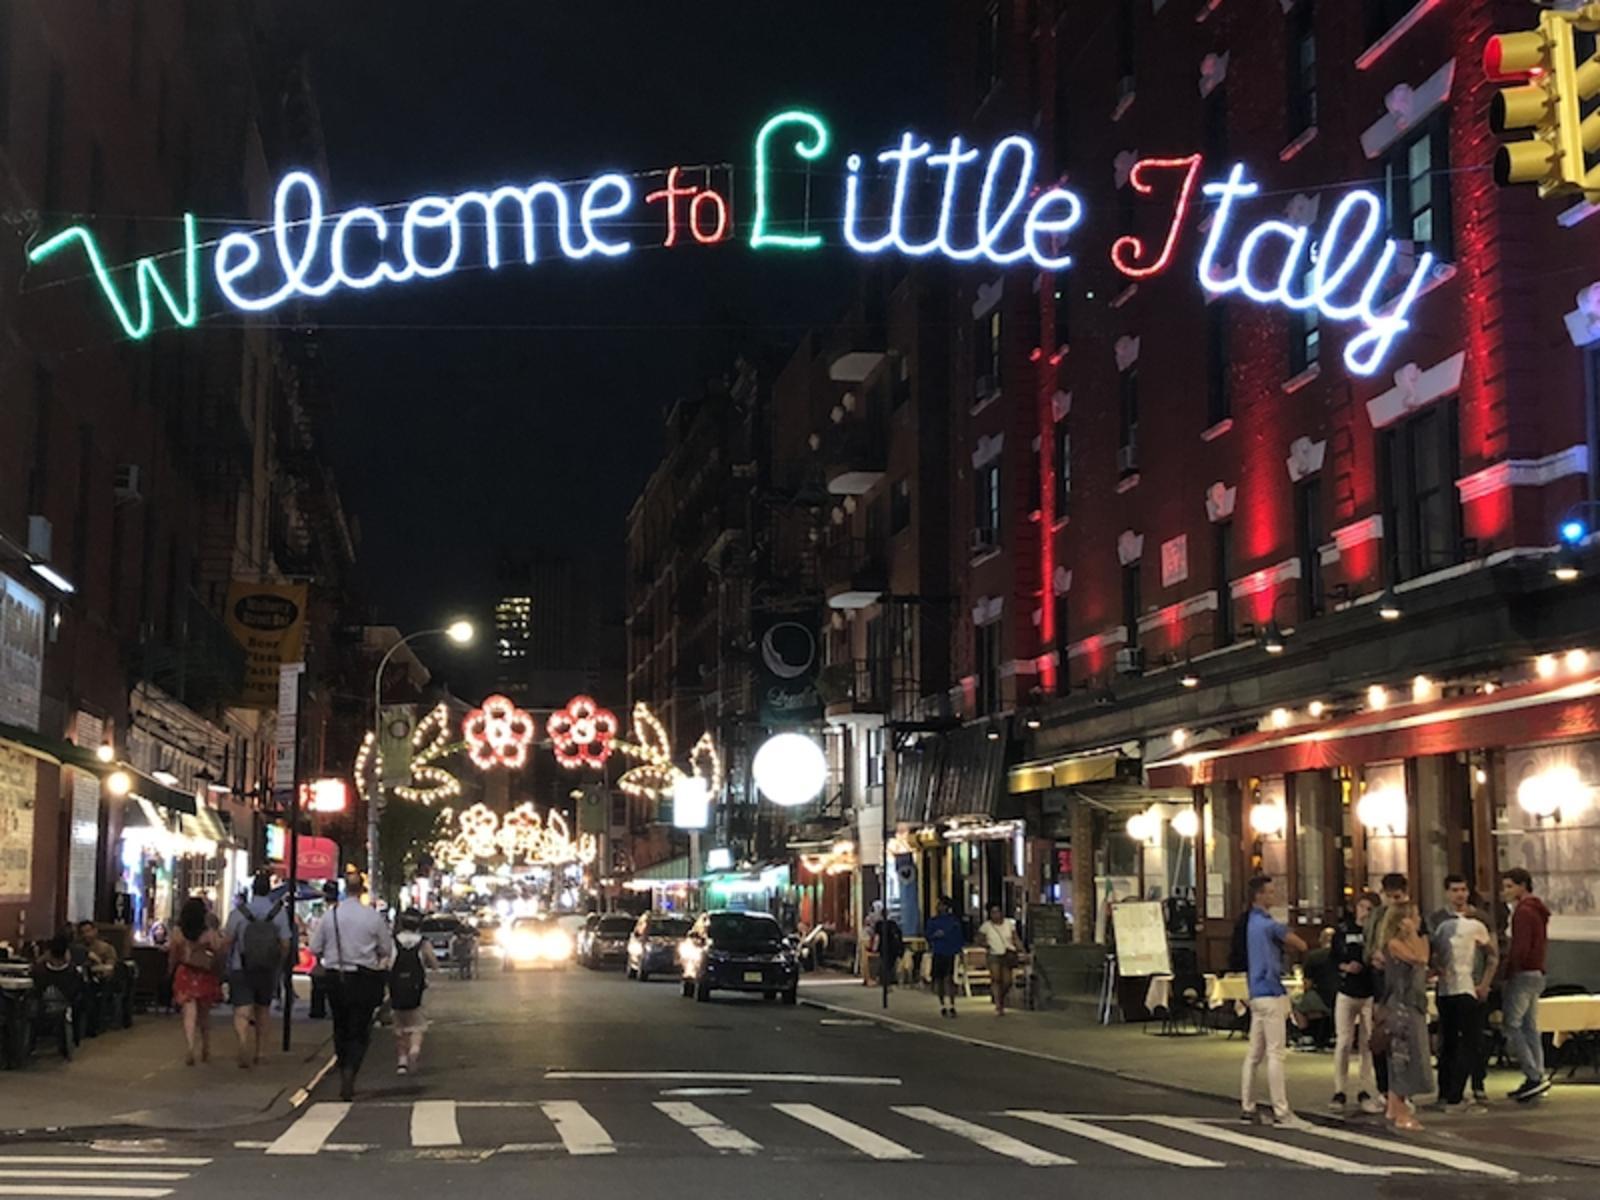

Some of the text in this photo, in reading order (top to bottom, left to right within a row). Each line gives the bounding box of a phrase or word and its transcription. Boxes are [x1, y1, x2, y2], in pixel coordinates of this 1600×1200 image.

[29, 111, 1434, 375] Welcome to Little Italy
[248, 636, 281, 649] Beer
